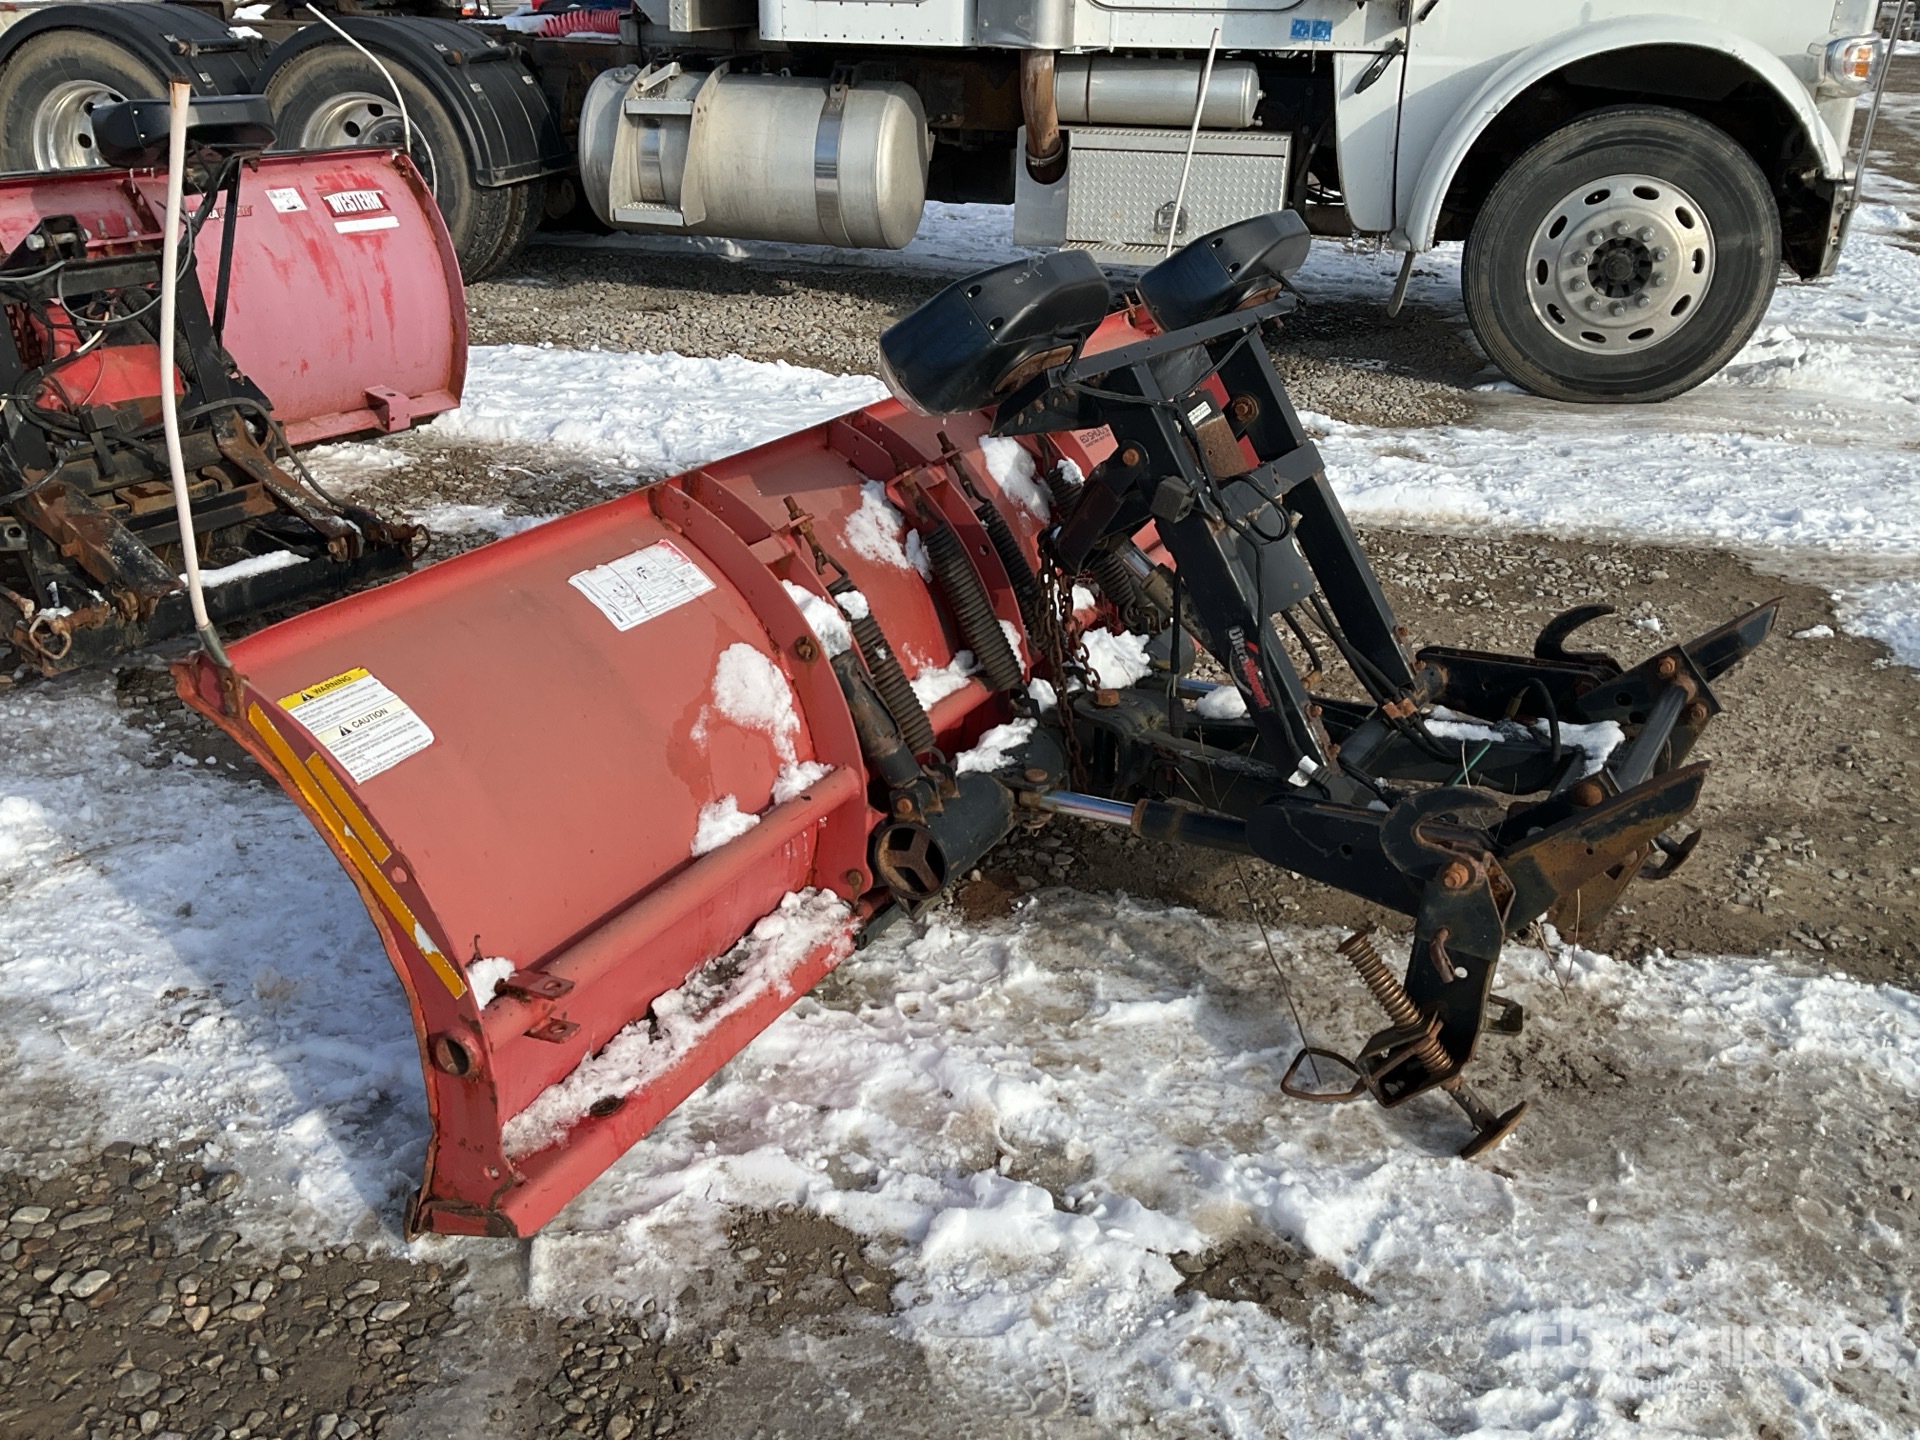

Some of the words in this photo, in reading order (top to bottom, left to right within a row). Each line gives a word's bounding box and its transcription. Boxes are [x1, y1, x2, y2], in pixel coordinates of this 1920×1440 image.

[322, 190, 384, 213] WESTERN
[311, 675, 352, 695] WARNING
[351, 707, 388, 728] CAUTION
